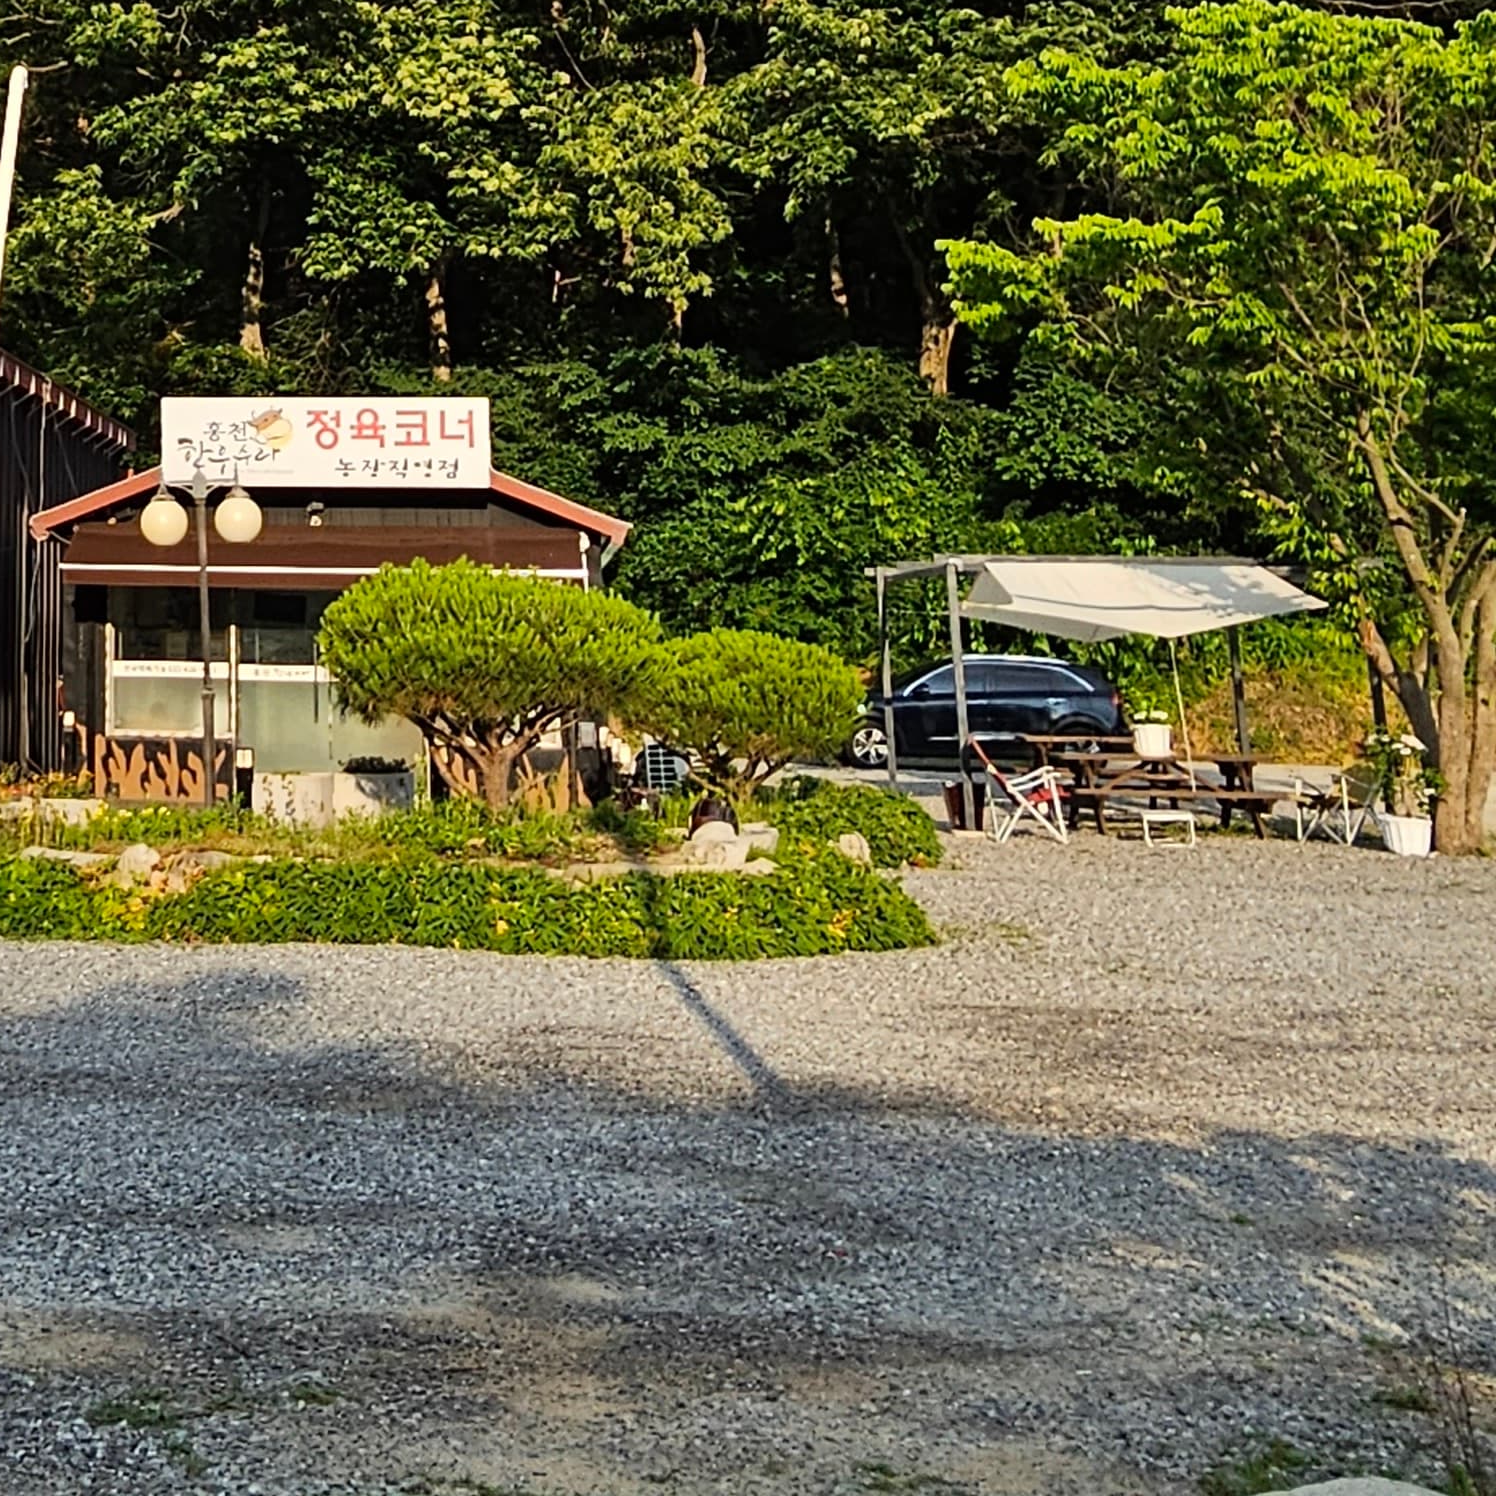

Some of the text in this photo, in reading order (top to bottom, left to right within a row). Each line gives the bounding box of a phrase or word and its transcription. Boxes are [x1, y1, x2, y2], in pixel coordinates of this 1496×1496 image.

[203, 421, 248, 442] 홍천
[305, 407, 476, 450] 정육코너
[177, 437, 281, 475] 한우수라
